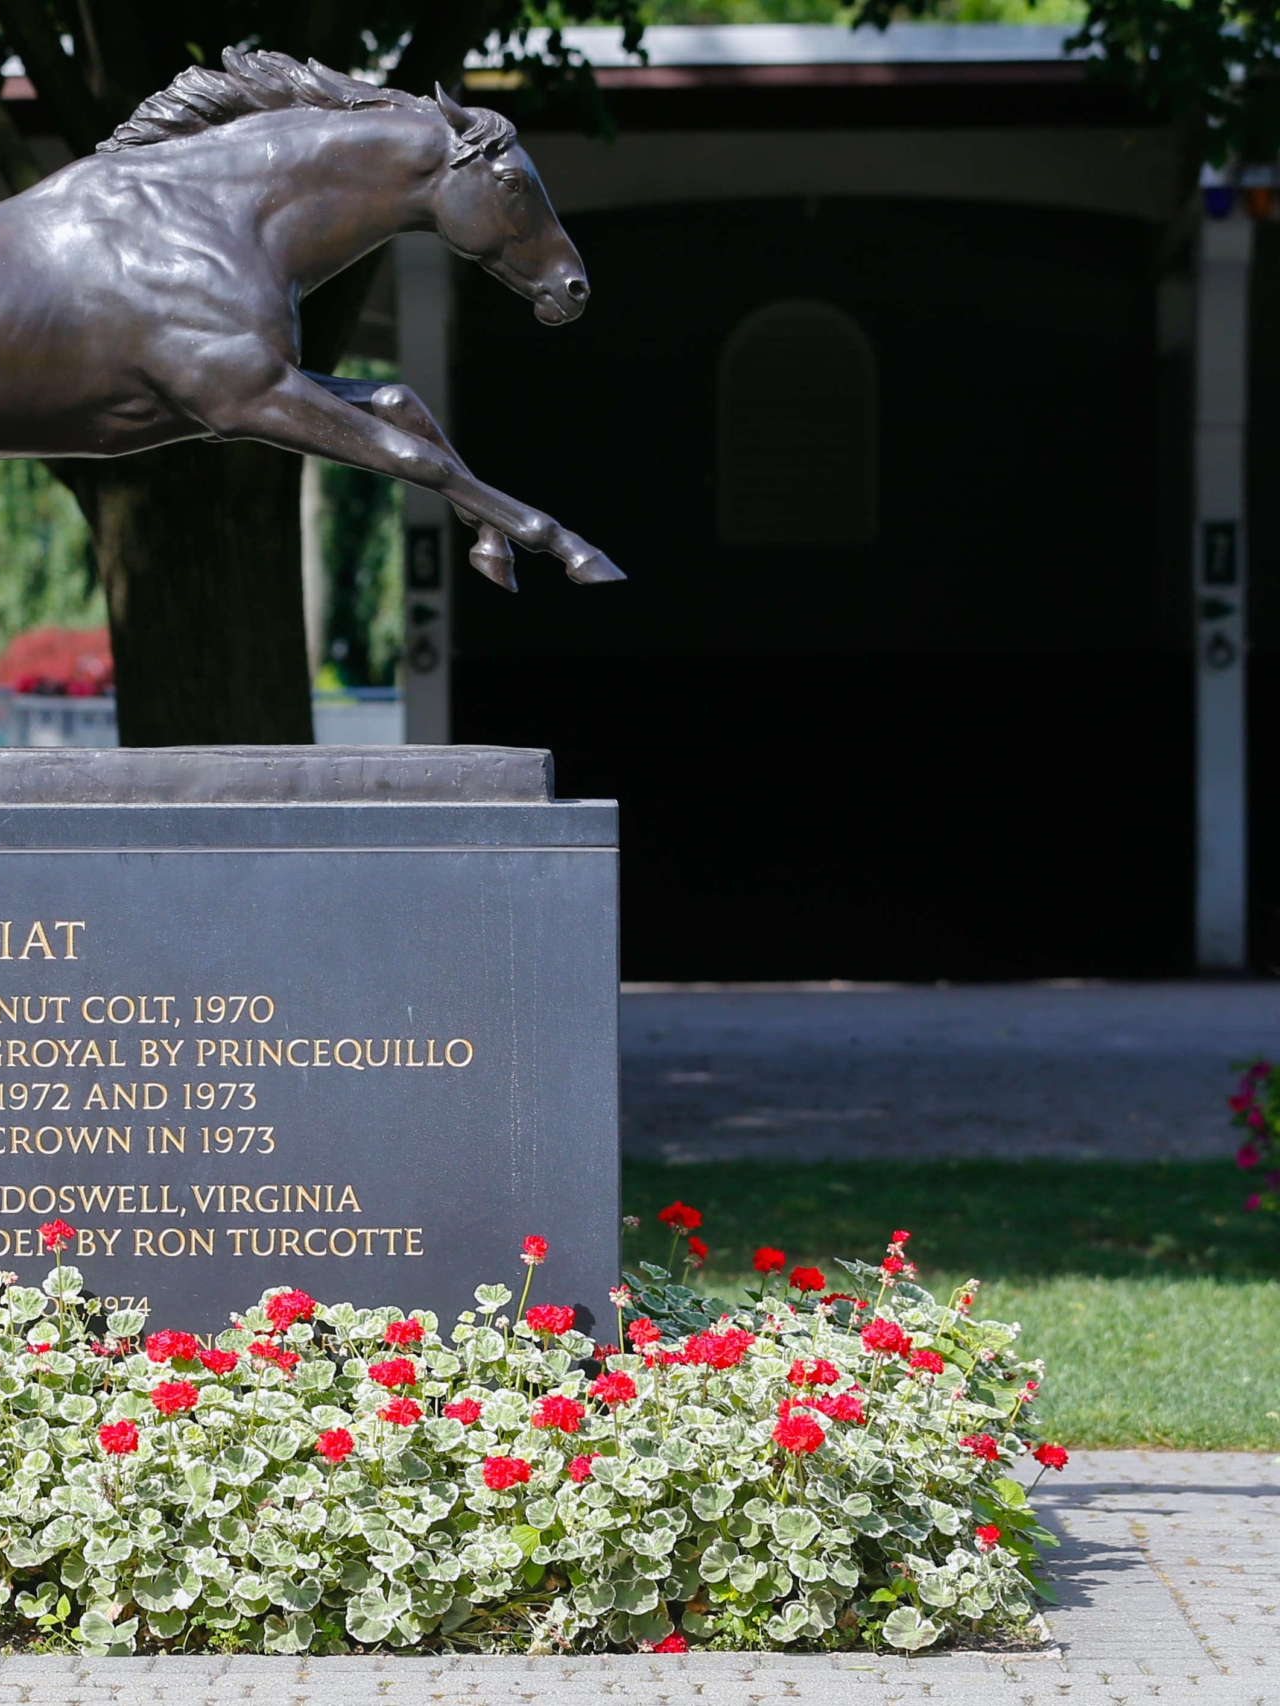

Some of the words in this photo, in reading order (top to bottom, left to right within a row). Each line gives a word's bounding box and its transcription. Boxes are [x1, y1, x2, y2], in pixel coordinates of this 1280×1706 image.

[80, 995, 181, 1028] COLT,
[193, 995, 277, 1024] 1970
[139, 1038, 185, 1067] BY
[195, 1038, 475, 1071] PRINCEQUILLO
[83, 1081, 169, 1110] AND
[183, 1082, 258, 1111] 1973
[146, 1125, 187, 1154] IN
[200, 1126, 277, 1154] 1973
[0, 1184, 187, 1219] DOSWELL,
[190, 1184, 362, 1213] VIRGINIA
[75, 1228, 122, 1257] BY
[133, 1227, 216, 1257] RON
[226, 1227, 425, 1257] TURCOTTE
